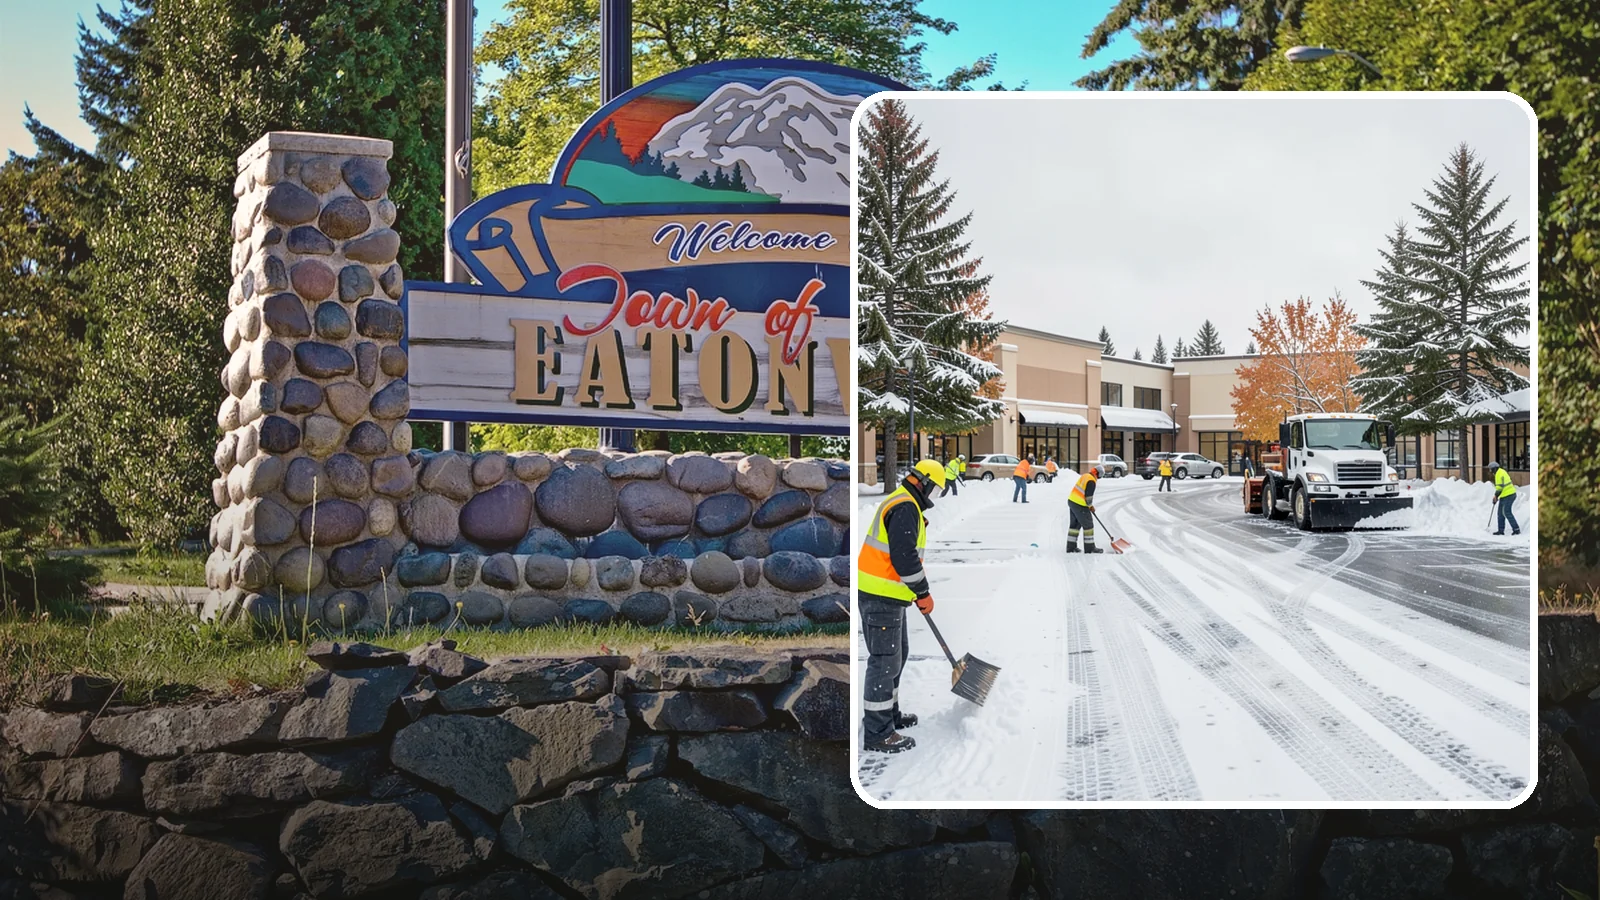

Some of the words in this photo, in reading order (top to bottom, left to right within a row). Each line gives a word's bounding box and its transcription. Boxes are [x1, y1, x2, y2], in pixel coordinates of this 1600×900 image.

[653, 221, 837, 263] Welcome
[556, 263, 736, 337] Town
[765, 278, 826, 366] of
